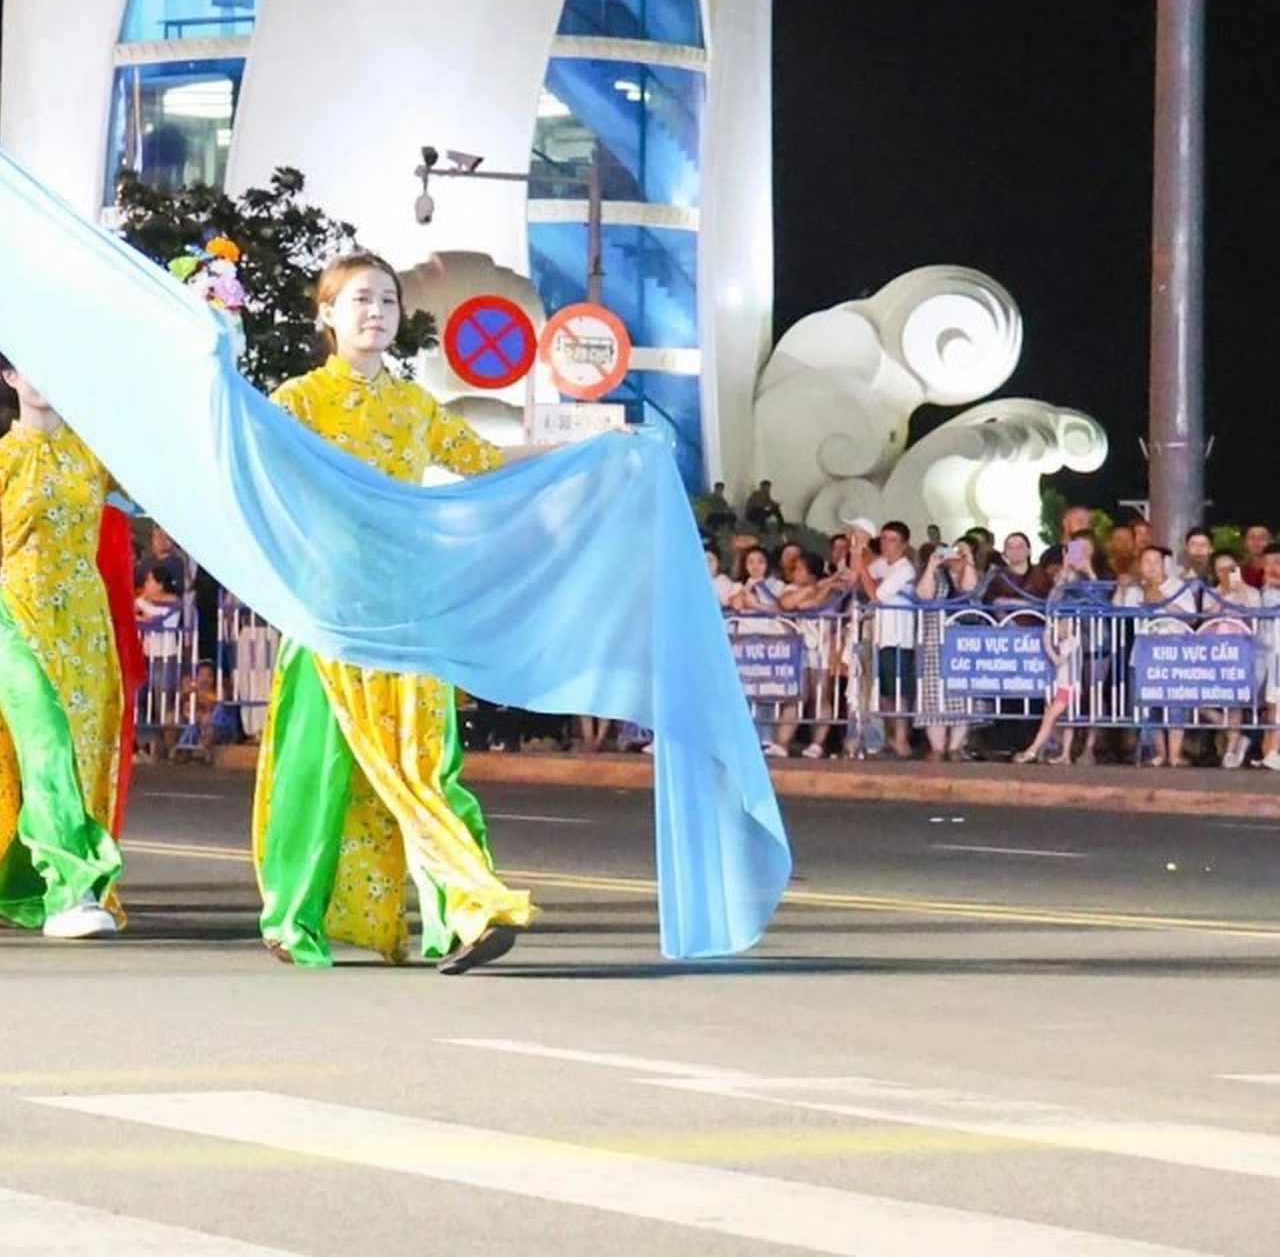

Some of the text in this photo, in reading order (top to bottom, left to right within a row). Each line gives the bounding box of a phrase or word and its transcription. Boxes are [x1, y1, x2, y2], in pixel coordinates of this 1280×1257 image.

[1152, 646, 1178, 661] KHU
[1210, 640, 1239, 661] CẤM
[1146, 665, 1169, 680] CÁC
